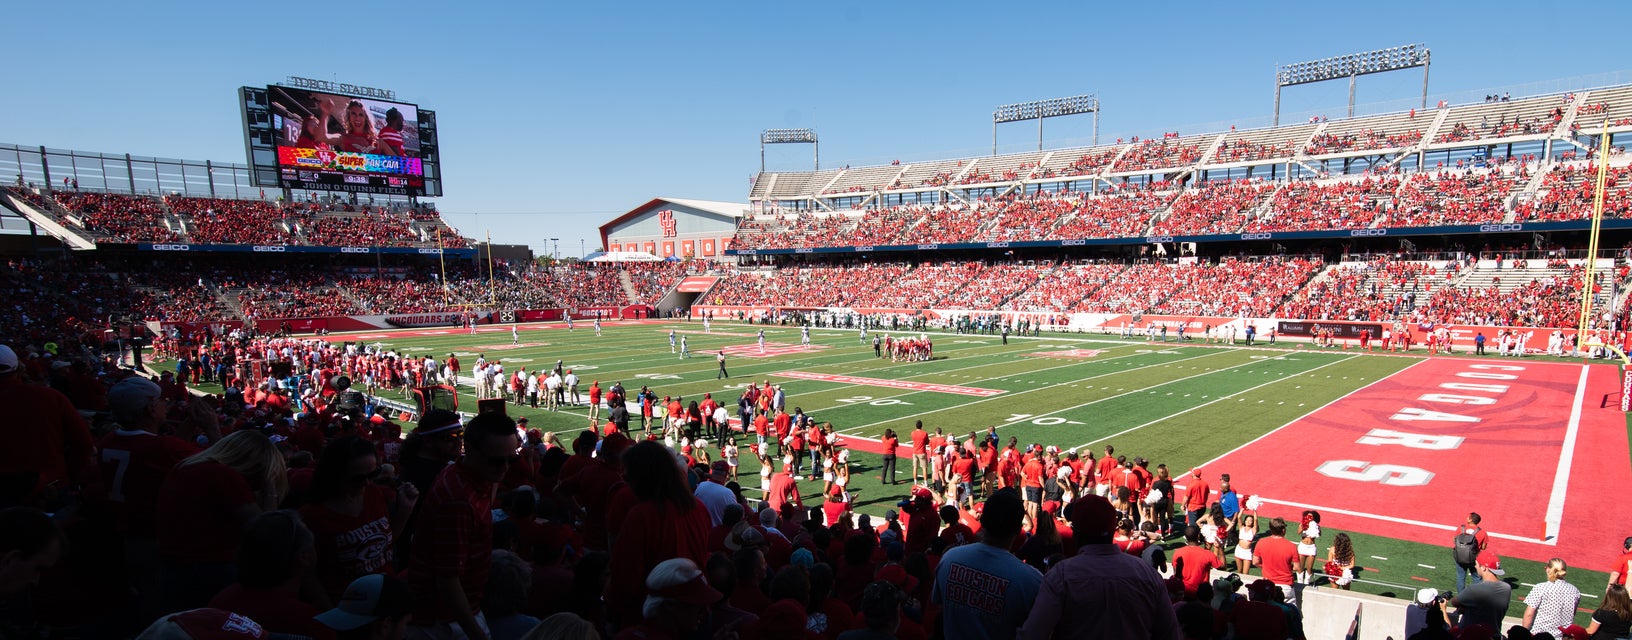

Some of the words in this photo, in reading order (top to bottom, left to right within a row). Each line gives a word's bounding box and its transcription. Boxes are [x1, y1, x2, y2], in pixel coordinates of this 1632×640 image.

[340, 83, 392, 99] STADIUM
[338, 156, 364, 166] SUPER
[382, 159, 399, 169] CAM
[302, 182, 331, 191] JOHN
[333, 183, 376, 193] O'QUINN
[378, 187, 407, 195] FIELD
[657, 209, 677, 238] UH
[1480, 223, 1522, 232] GEICO
[1240, 232, 1272, 240] GEICO
[1350, 228, 1387, 237] GEICO
[501, 311, 514, 321] 25
[1005, 413, 1068, 426] 10
[1313, 363, 1527, 487] COUGARS
[102, 448, 131, 504] 7
[949, 562, 1010, 598] HOUSTON
[946, 582, 1004, 616] COUGARS
